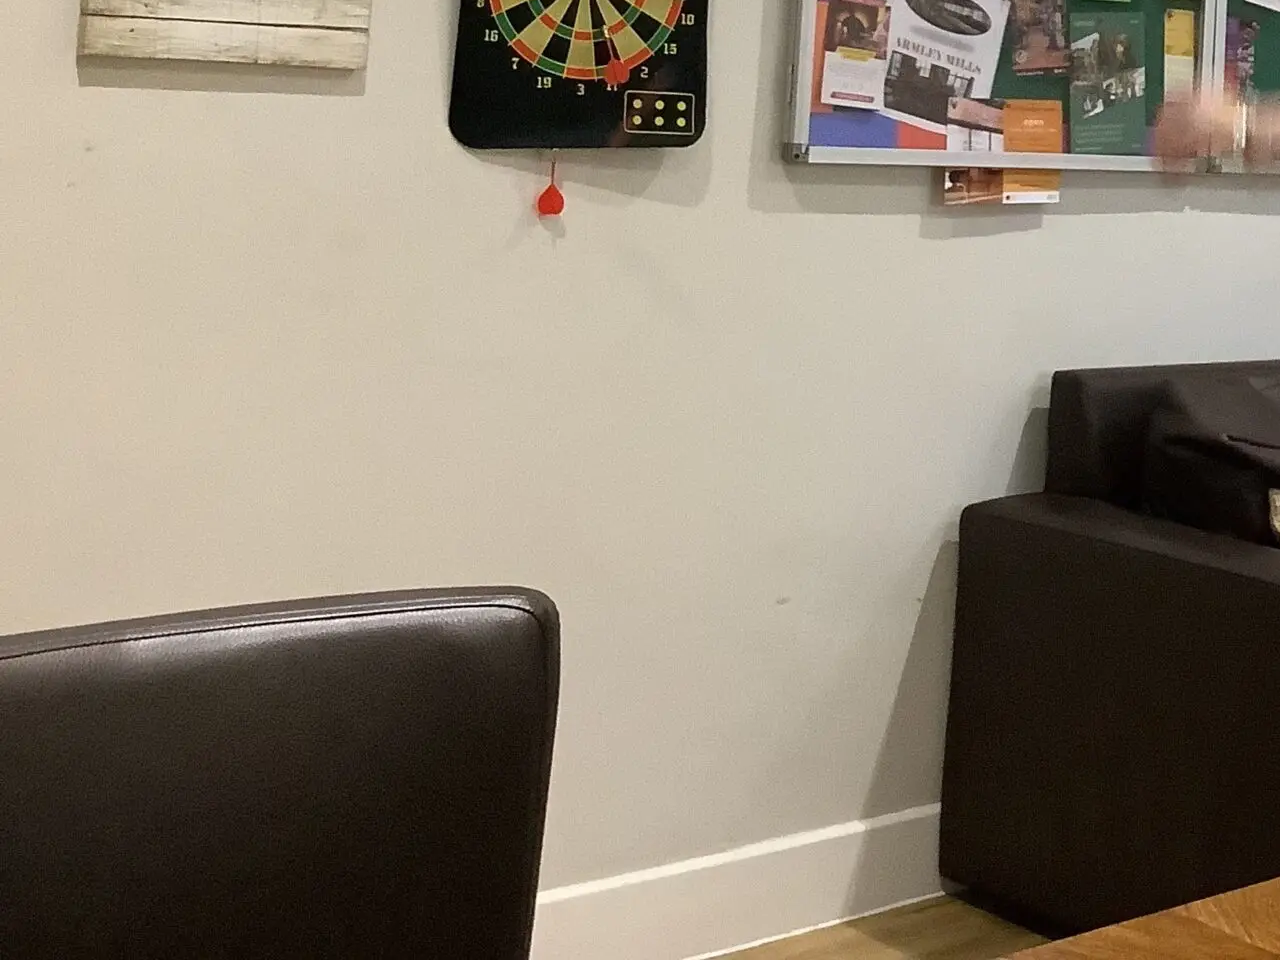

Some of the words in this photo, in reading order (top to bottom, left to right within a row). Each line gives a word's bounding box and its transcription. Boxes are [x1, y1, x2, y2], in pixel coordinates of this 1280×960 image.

[681, 14, 695, 26] 10
[484, 29, 498, 42] 16
[664, 43, 677, 55] 15
[511, 58, 520, 70] 7
[641, 66, 649, 78] 2
[537, 76, 552, 89] 19
[577, 83, 585, 96] 3
